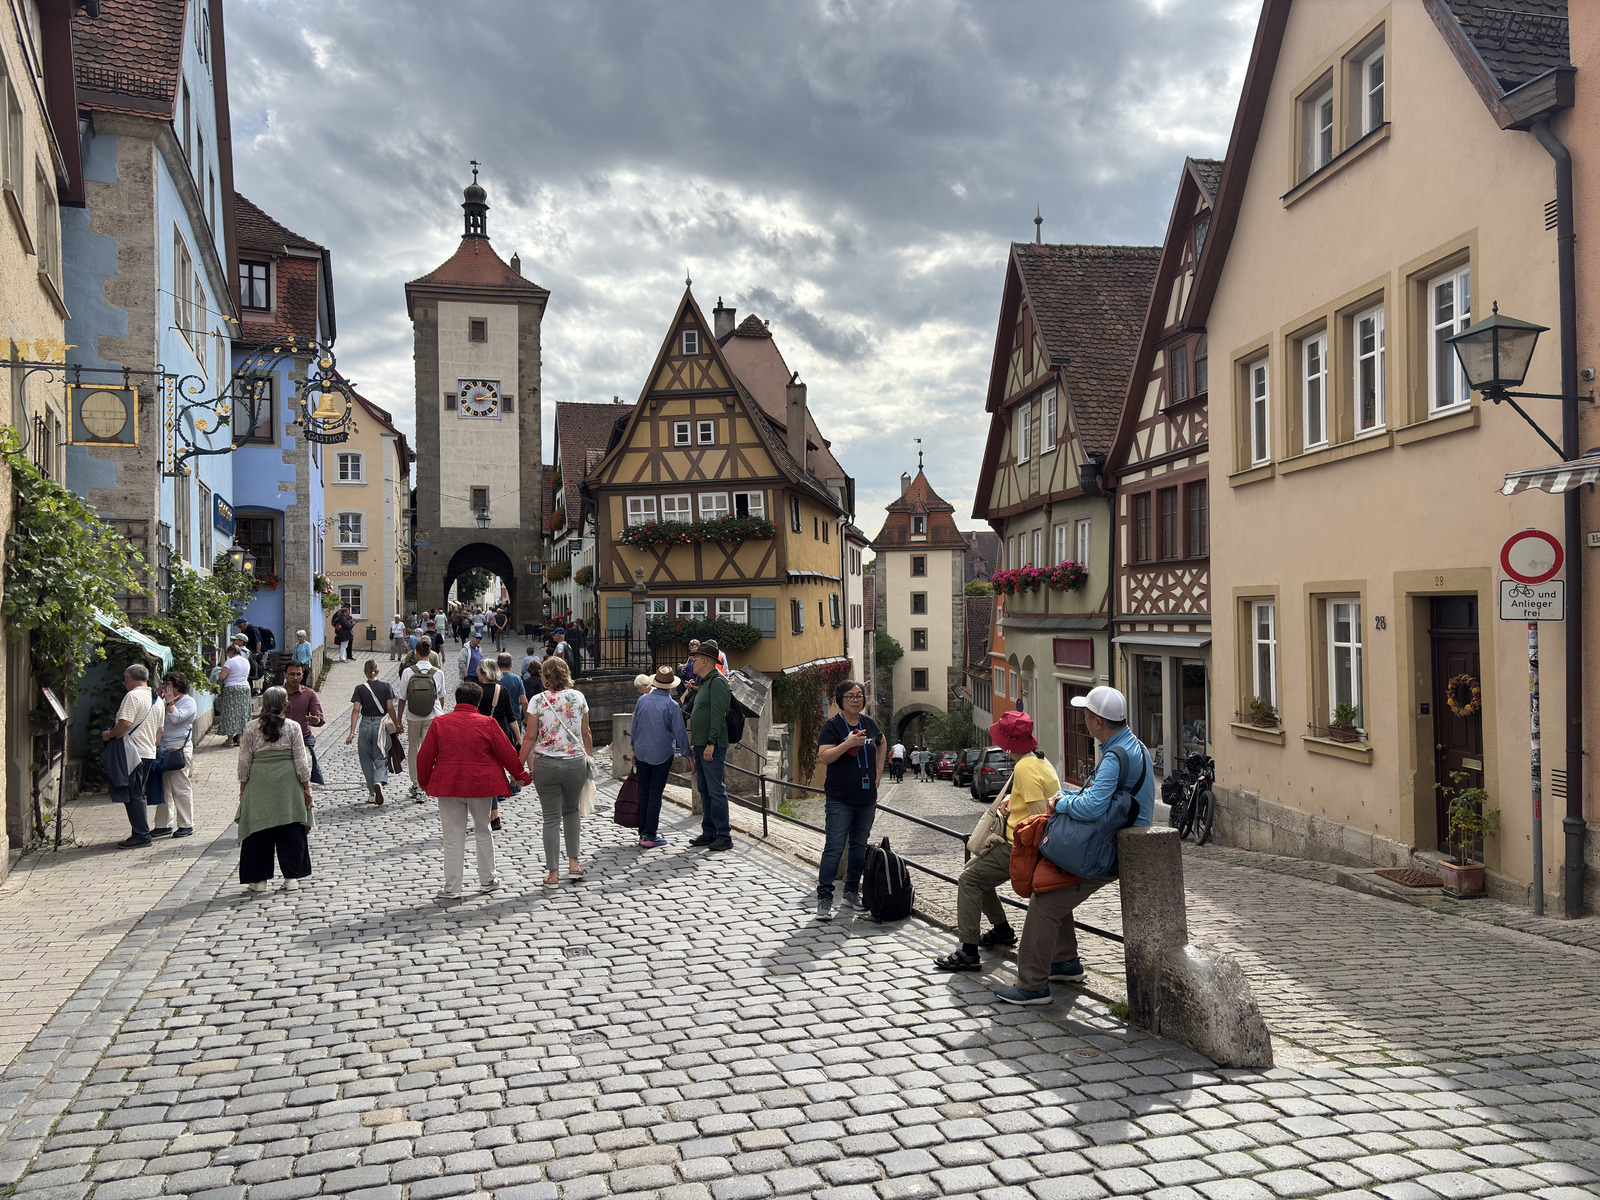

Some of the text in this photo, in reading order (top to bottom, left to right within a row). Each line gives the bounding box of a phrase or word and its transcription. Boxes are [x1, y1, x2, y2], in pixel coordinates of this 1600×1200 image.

[308, 432, 345, 442] GASTHOF
[1435, 575, 1443, 586] 28
[1511, 600, 1552, 609] Anlieger
[1523, 609, 1540, 617] frei
[1375, 616, 1386, 630] 28
